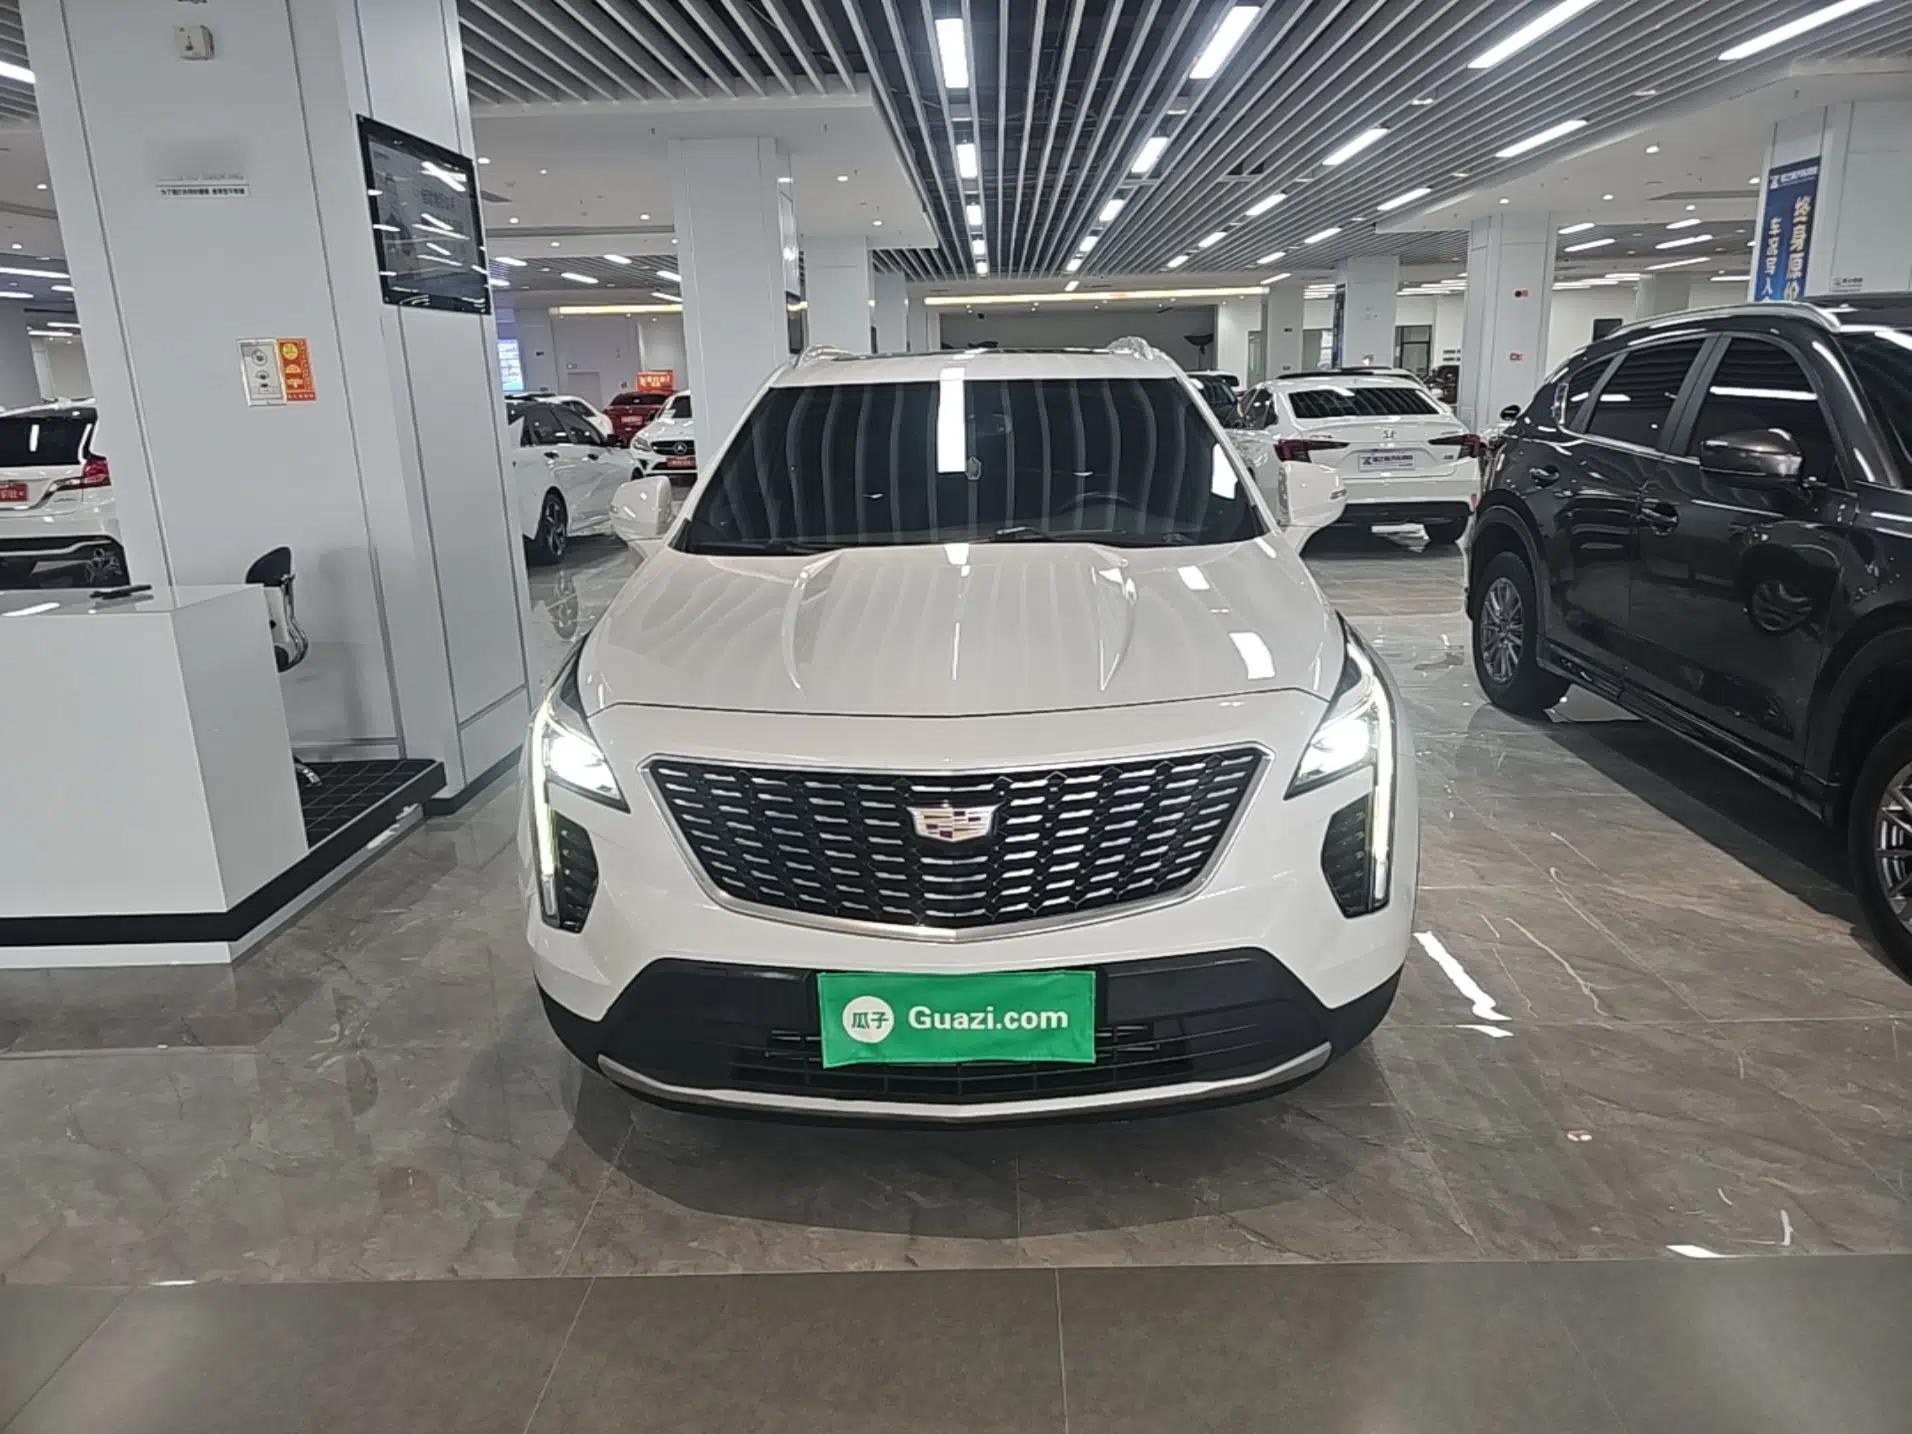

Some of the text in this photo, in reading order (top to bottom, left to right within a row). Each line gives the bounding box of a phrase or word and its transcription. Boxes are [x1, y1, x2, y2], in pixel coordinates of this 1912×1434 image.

[1763, 217, 1781, 301] 车况写入
[851, 1011, 889, 1029] 瓜子
[908, 1005, 1069, 1030] Guazi.com
